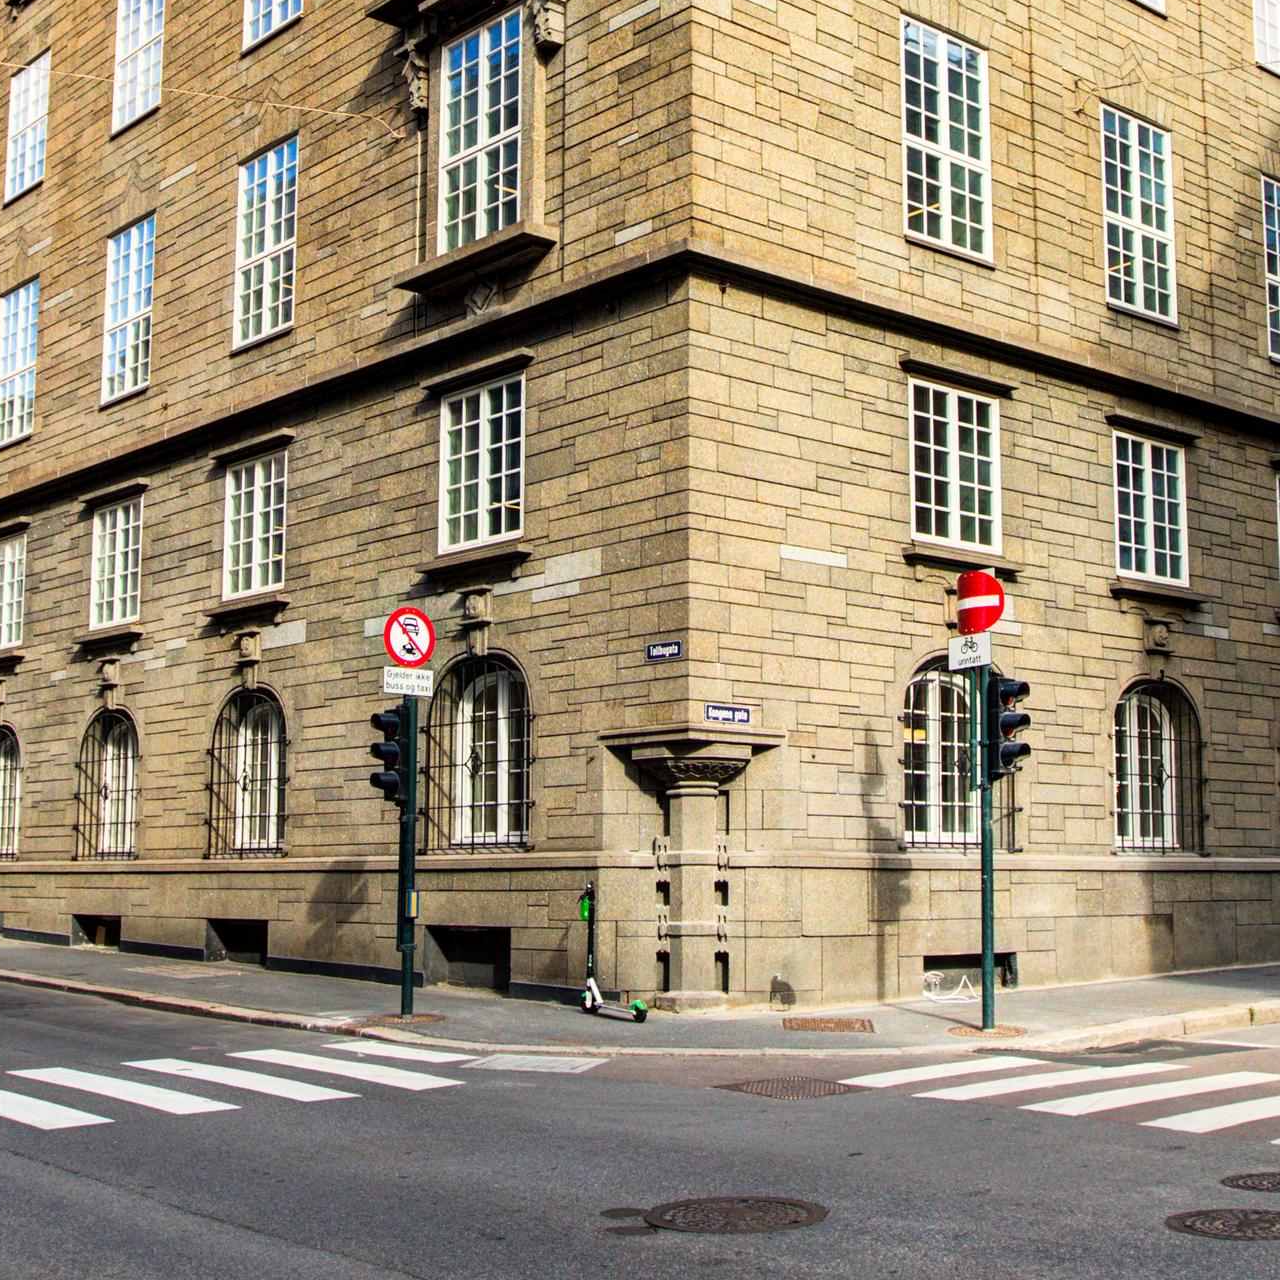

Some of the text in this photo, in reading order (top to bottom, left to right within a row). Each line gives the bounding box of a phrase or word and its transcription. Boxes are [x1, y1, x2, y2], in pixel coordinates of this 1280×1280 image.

[958, 655, 982, 666] unntatt
[386, 669, 431, 682] Gjelder ikke
[386, 681, 431, 693] buss og taxi
